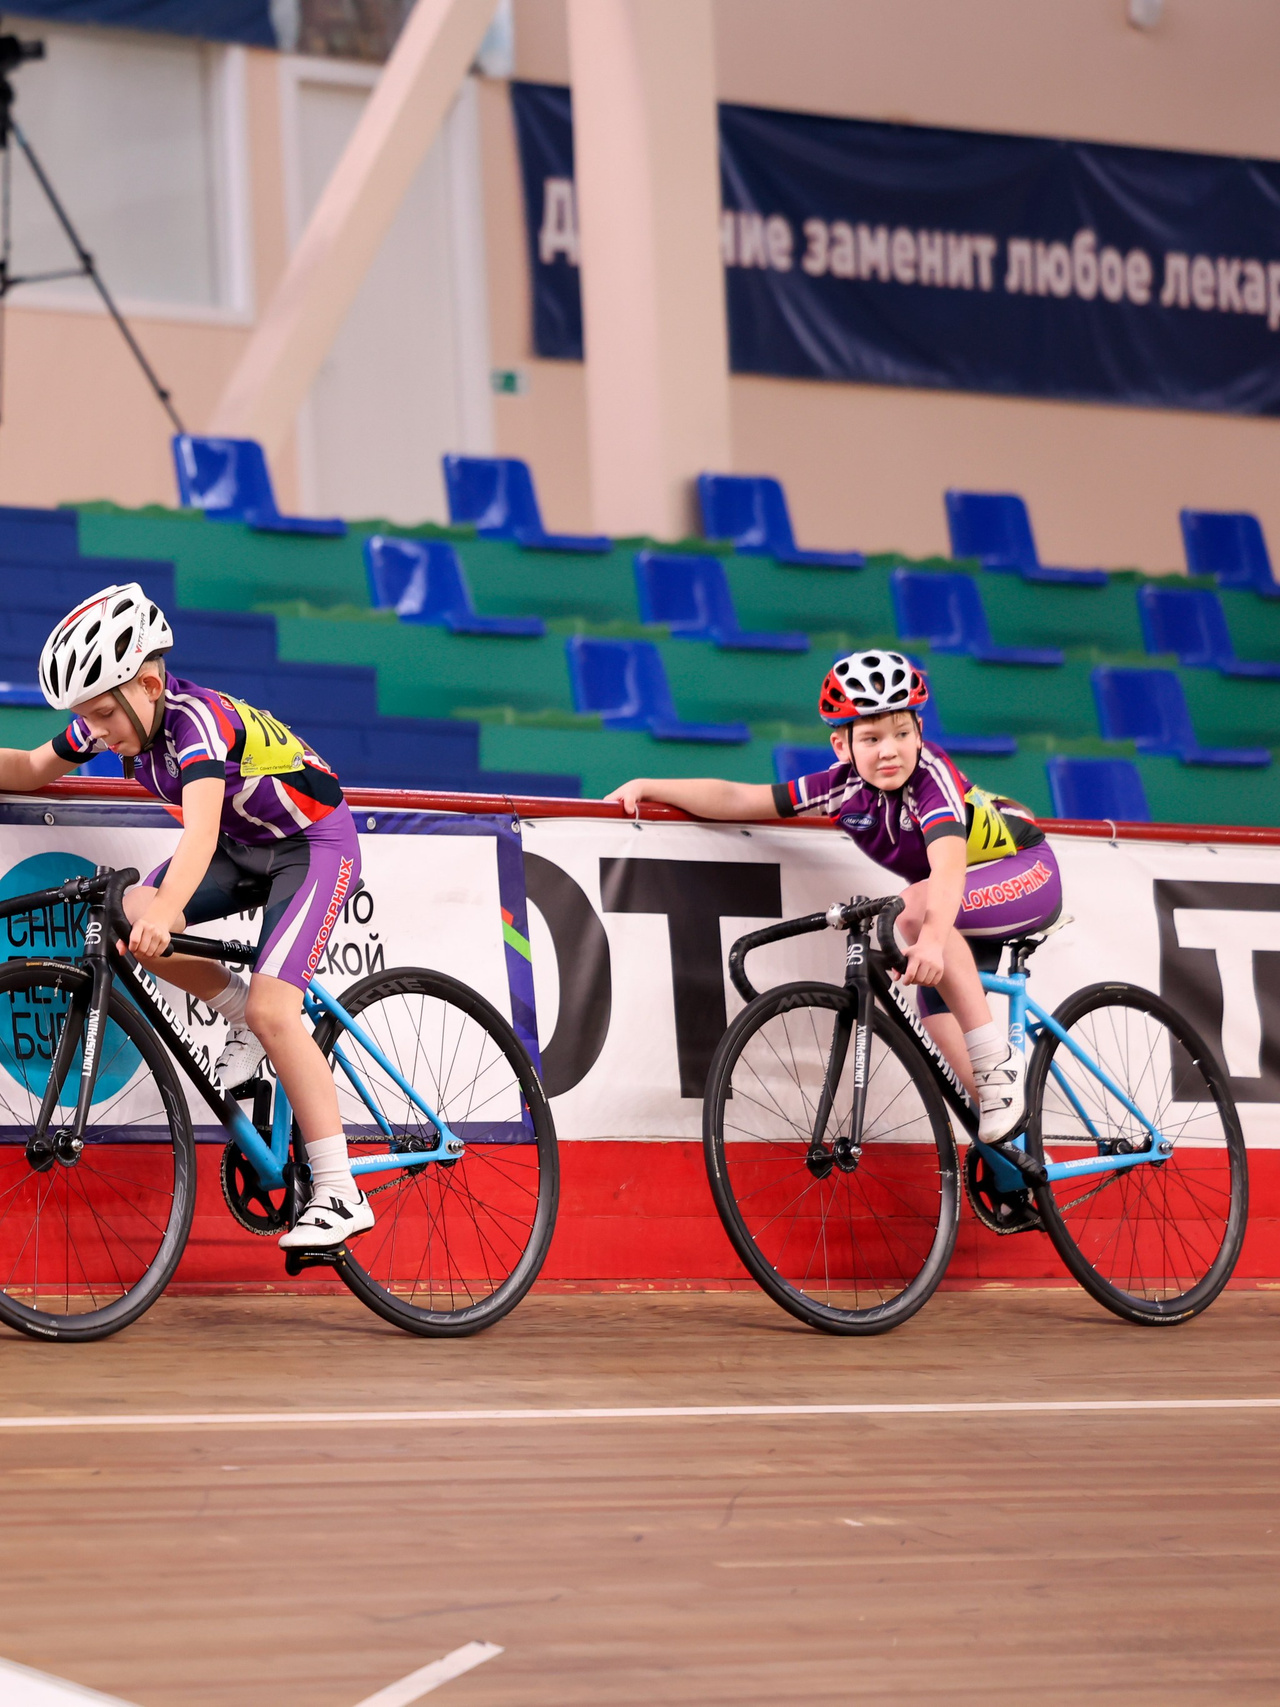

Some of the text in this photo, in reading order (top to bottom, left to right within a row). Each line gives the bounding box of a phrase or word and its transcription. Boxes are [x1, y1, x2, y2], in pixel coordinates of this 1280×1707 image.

[803, 215, 997, 293] заменит
[1005, 227, 1153, 305] любое
[248, 708, 288, 747] 10
[982, 809, 1007, 850] 12
[302, 855, 355, 983] LOKOSPHINX
[961, 860, 1052, 912] LOKOSPHINX
[81, 1007, 101, 1078] LOKOSPHINX
[132, 962, 228, 1104] LOKOSPHINX
[854, 1024, 868, 1089] LOKOSPHINX
[888, 980, 972, 1109] LOKOSPHINX
[348, 1153, 400, 1166] OKOSPHINX
